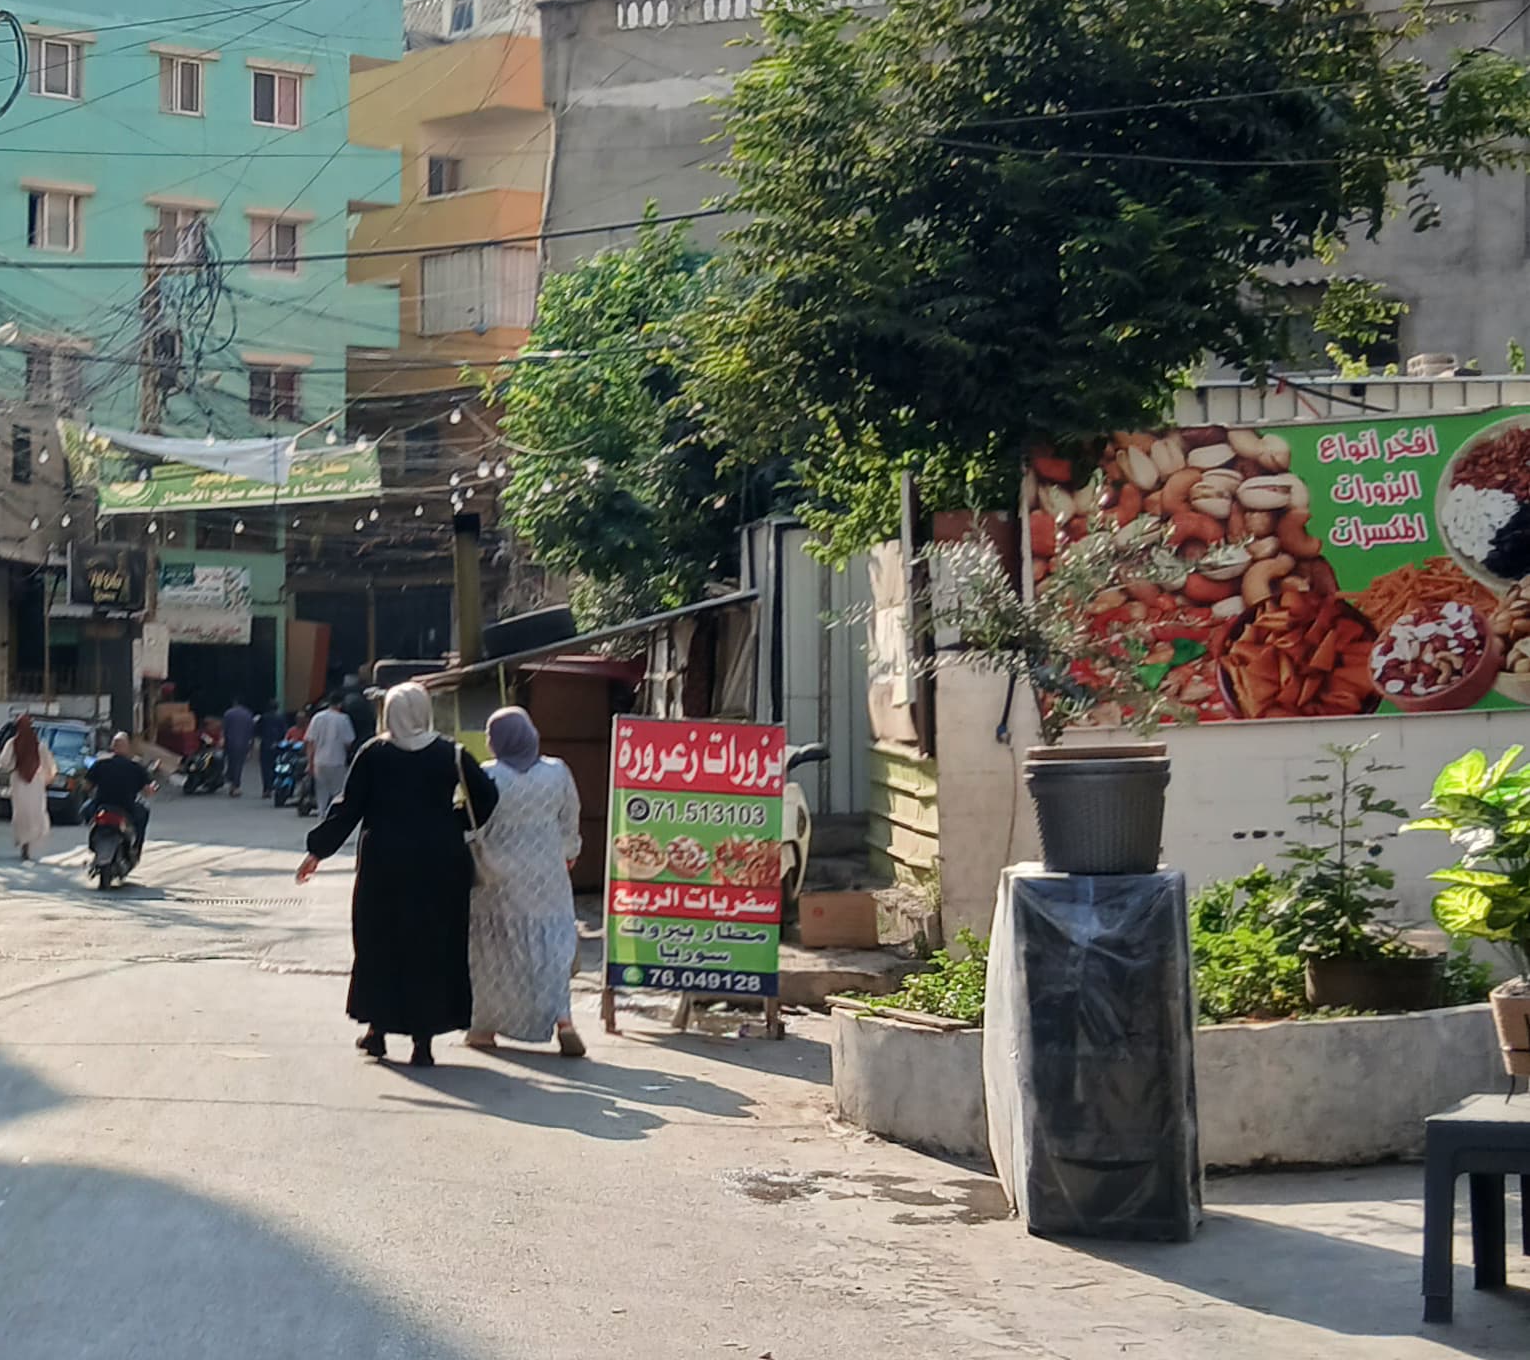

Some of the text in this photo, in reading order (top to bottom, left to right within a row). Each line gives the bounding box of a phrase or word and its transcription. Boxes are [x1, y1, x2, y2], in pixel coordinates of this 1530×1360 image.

[1334, 472, 1420, 505] البزورات
[1331, 515, 1426, 548] المكسرات
[618, 726, 783, 788] بزورات زعرورة
[651, 799, 767, 827] 71.513103
[613, 886, 777, 916] سفريات الربيع
[620, 917, 769, 944] مطار بيروت
[658, 943, 730, 966] سوريا
[648, 968, 762, 992] 76.049128
